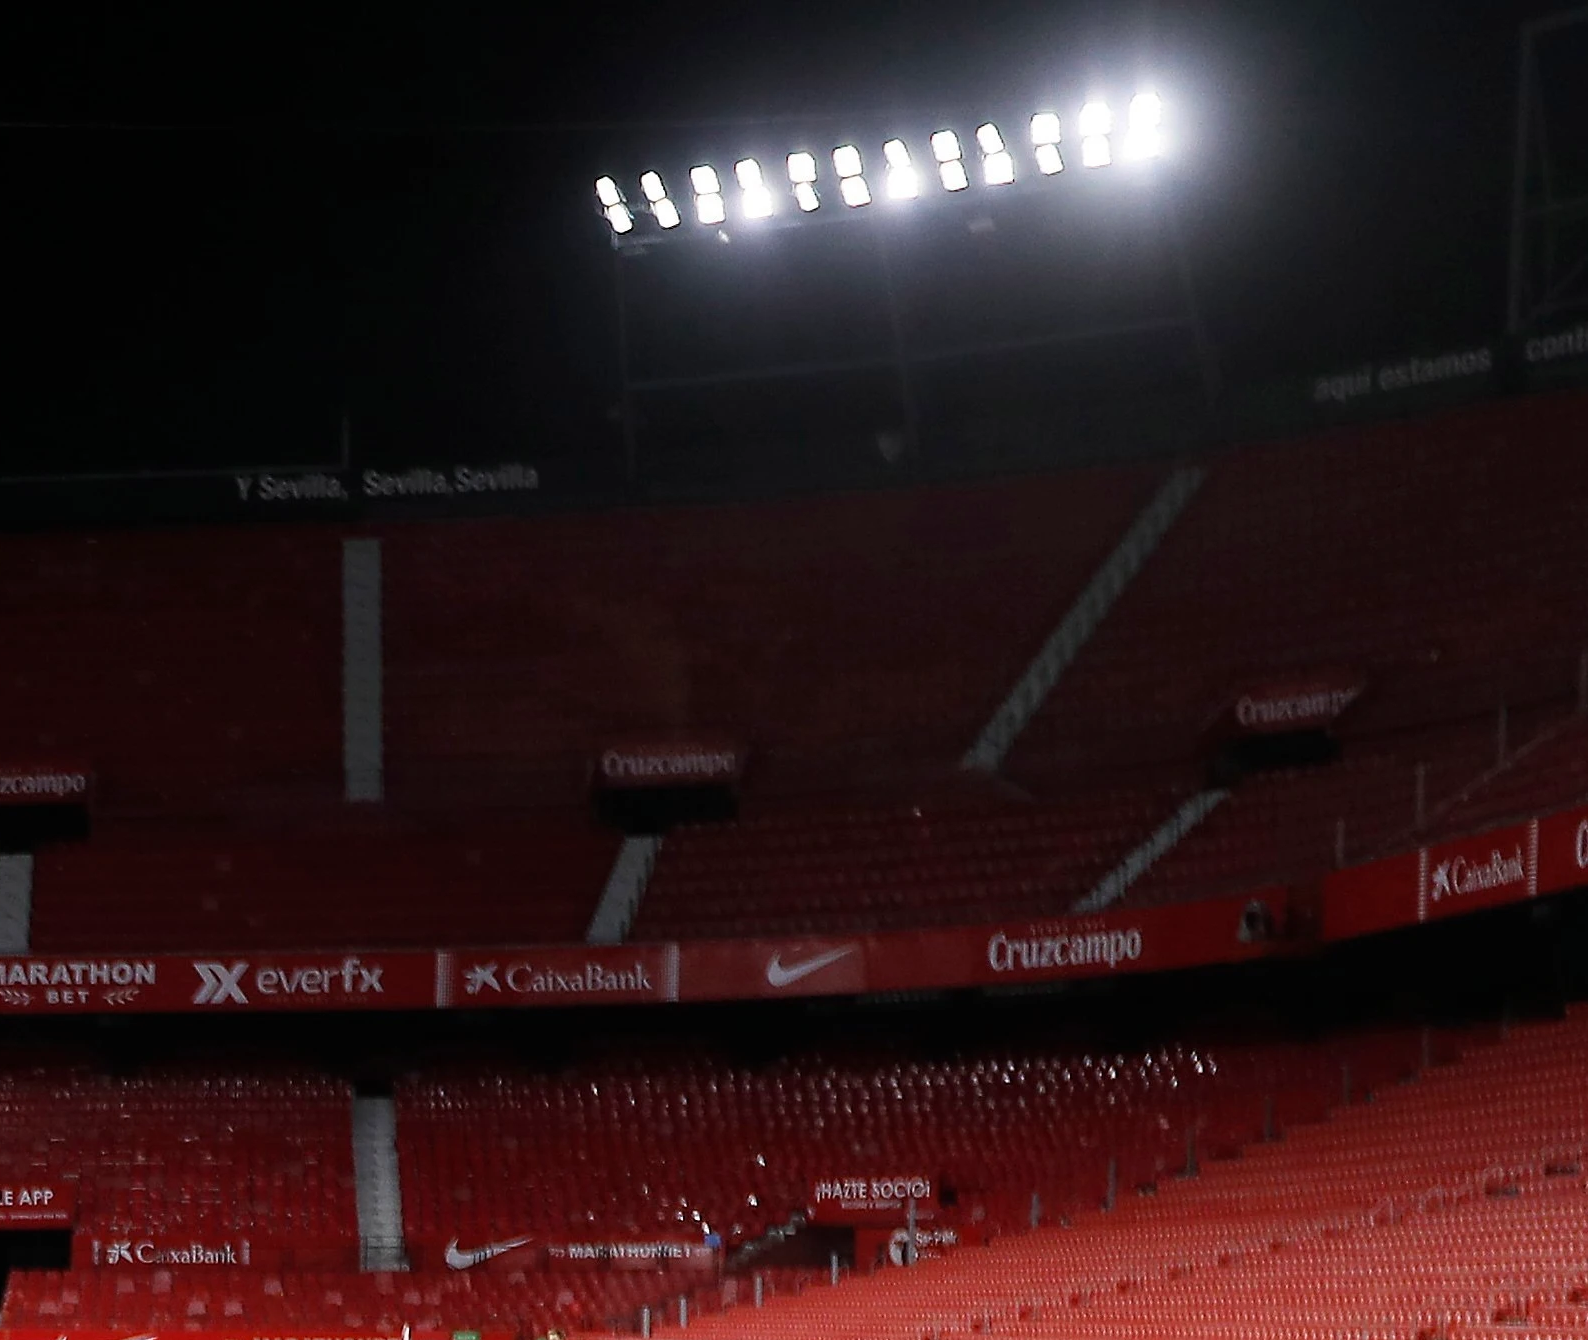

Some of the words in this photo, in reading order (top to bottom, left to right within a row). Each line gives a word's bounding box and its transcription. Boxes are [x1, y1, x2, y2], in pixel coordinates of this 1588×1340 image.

[987, 928, 1143, 973] Cruzcampo
[255, 957, 385, 996] everfx
[505, 963, 653, 993] CaixaBank
[45, 988, 90, 1005] BET
[19, 1189, 54, 1206] APP
